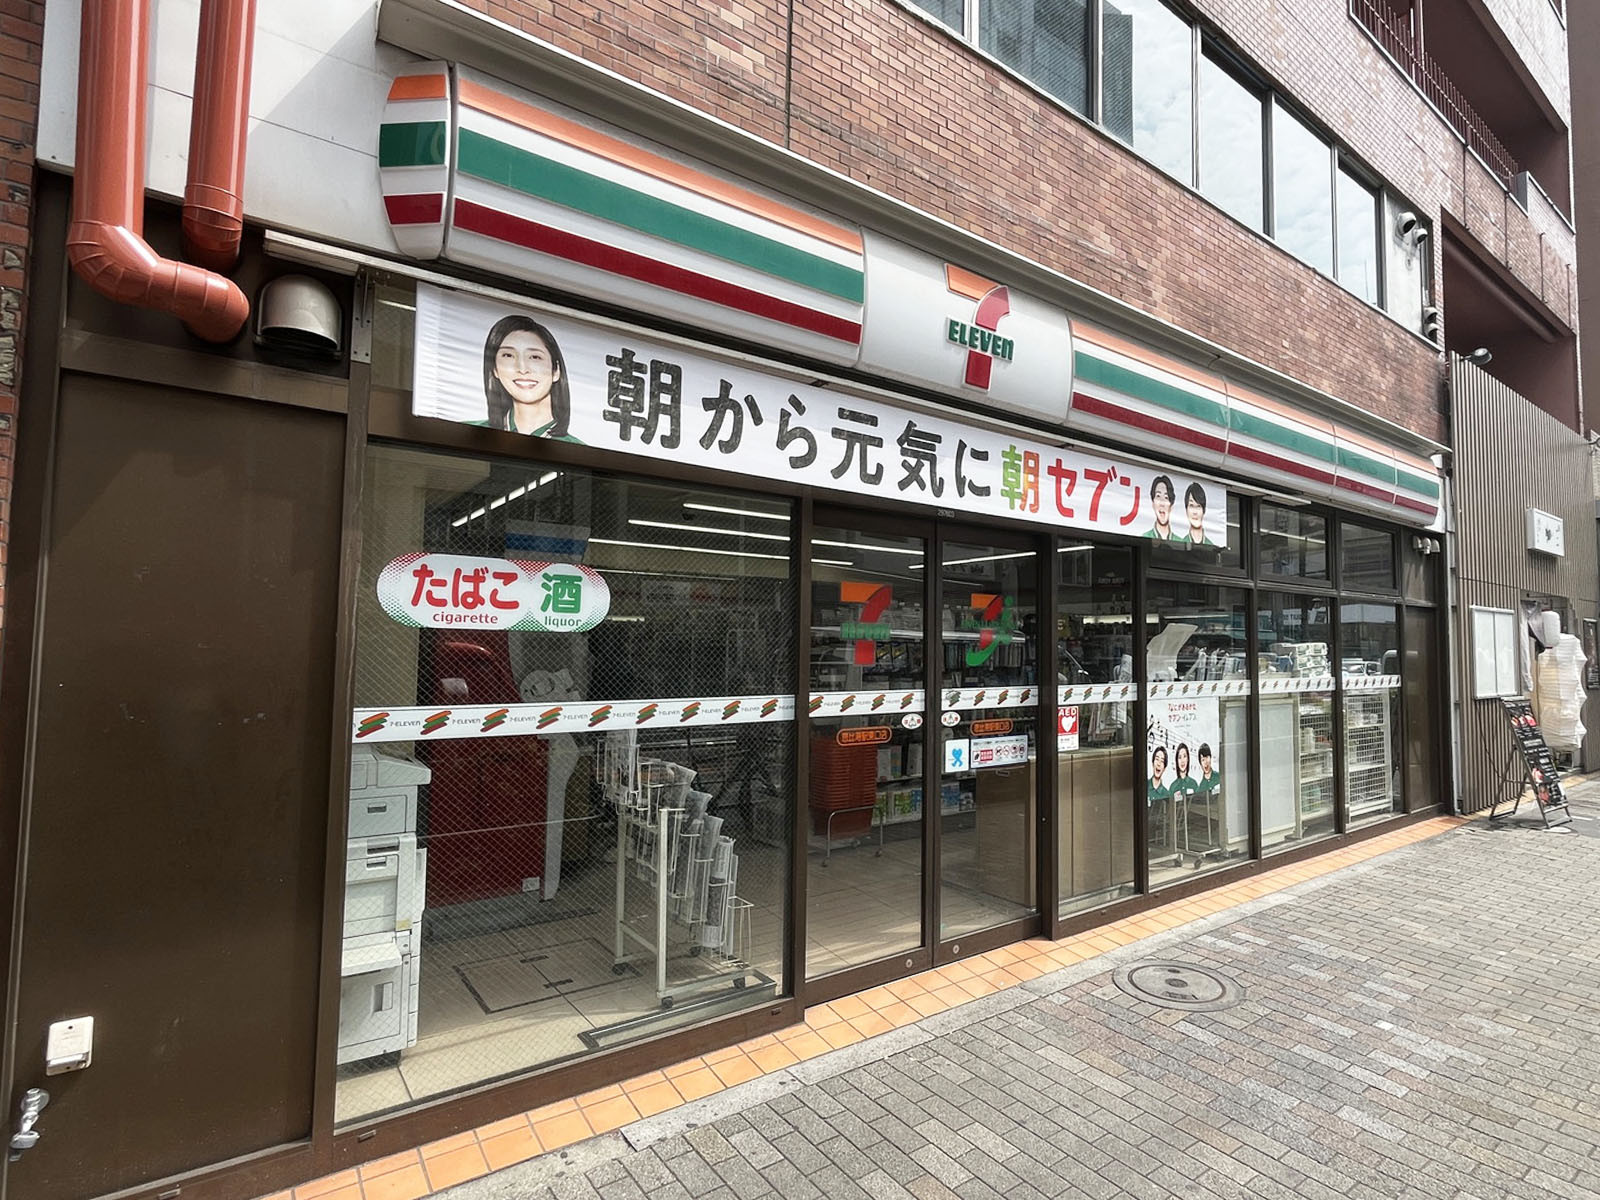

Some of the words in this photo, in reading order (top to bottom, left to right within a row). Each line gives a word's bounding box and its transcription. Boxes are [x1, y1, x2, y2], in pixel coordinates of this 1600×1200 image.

[946, 263, 1010, 390] 7
[411, 563, 520, 611] たばこ
[540, 572, 583, 614] 酒
[432, 611, 499, 627] cigarette
[544, 615, 583, 630] liquor
[1058, 706, 1077, 717] AED
